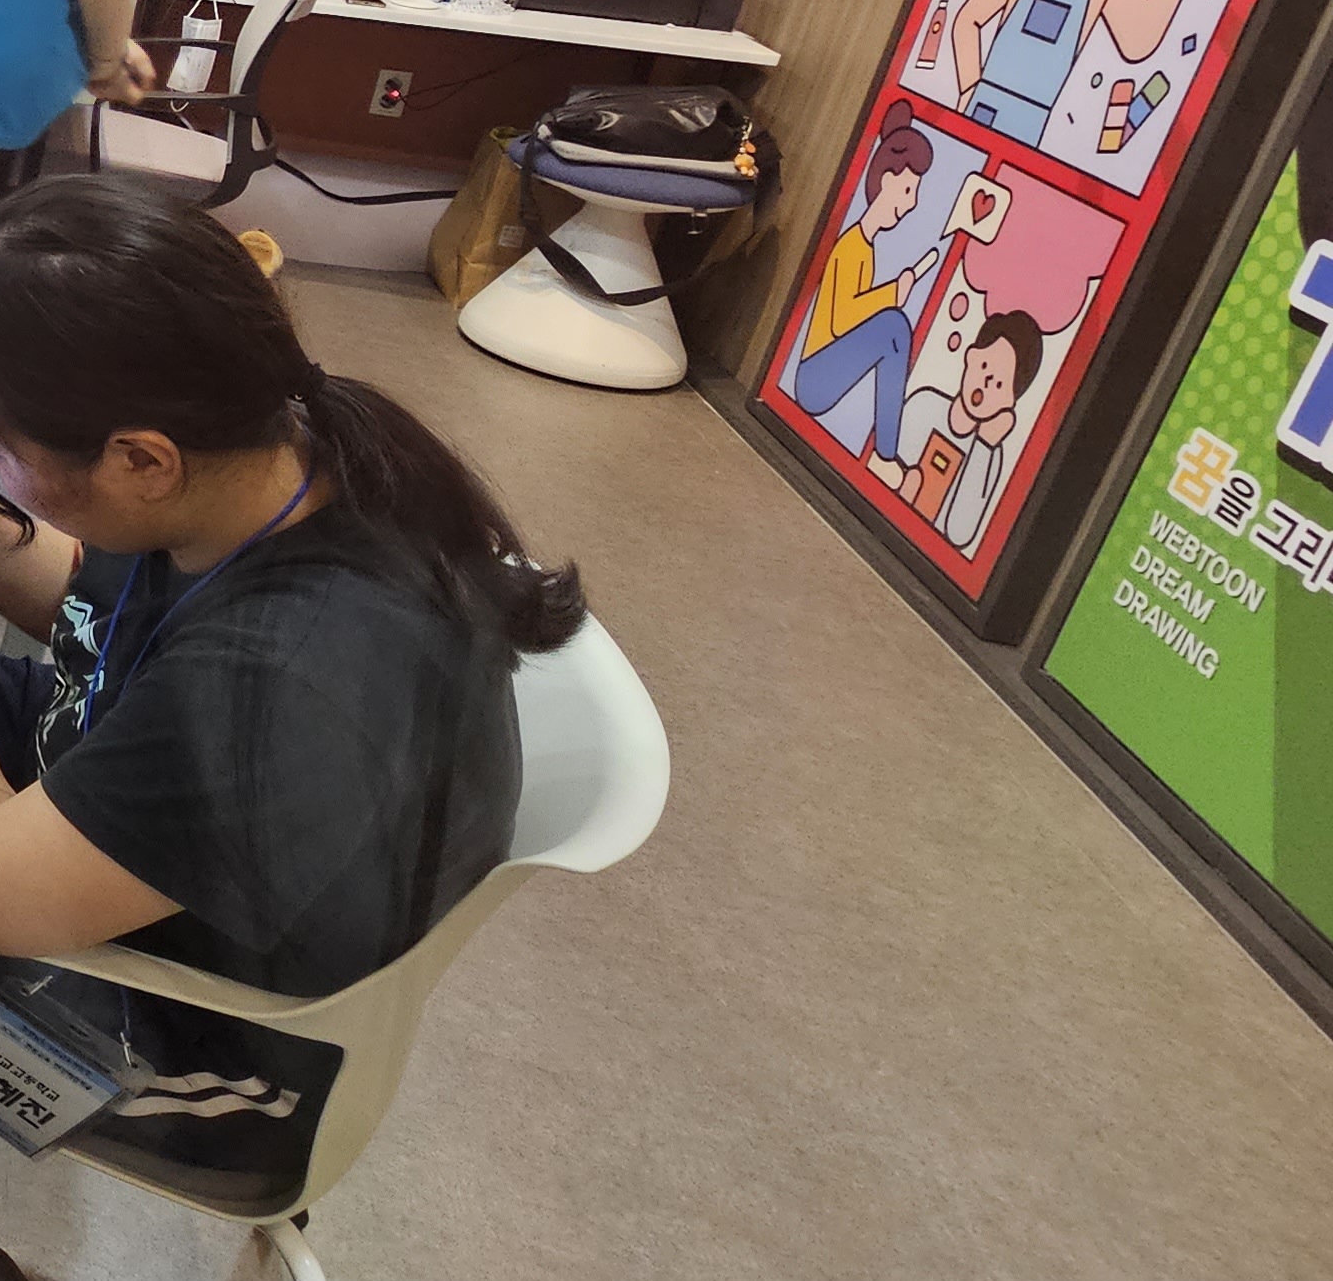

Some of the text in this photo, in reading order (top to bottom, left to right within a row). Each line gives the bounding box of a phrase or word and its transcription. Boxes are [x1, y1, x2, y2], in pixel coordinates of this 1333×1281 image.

[1173, 433, 1333, 585] 꿈을 그리
[1129, 546, 1215, 624] DREAM
[1148, 510, 1266, 612] WEBTOON
[1113, 579, 1220, 679] DRAWING
